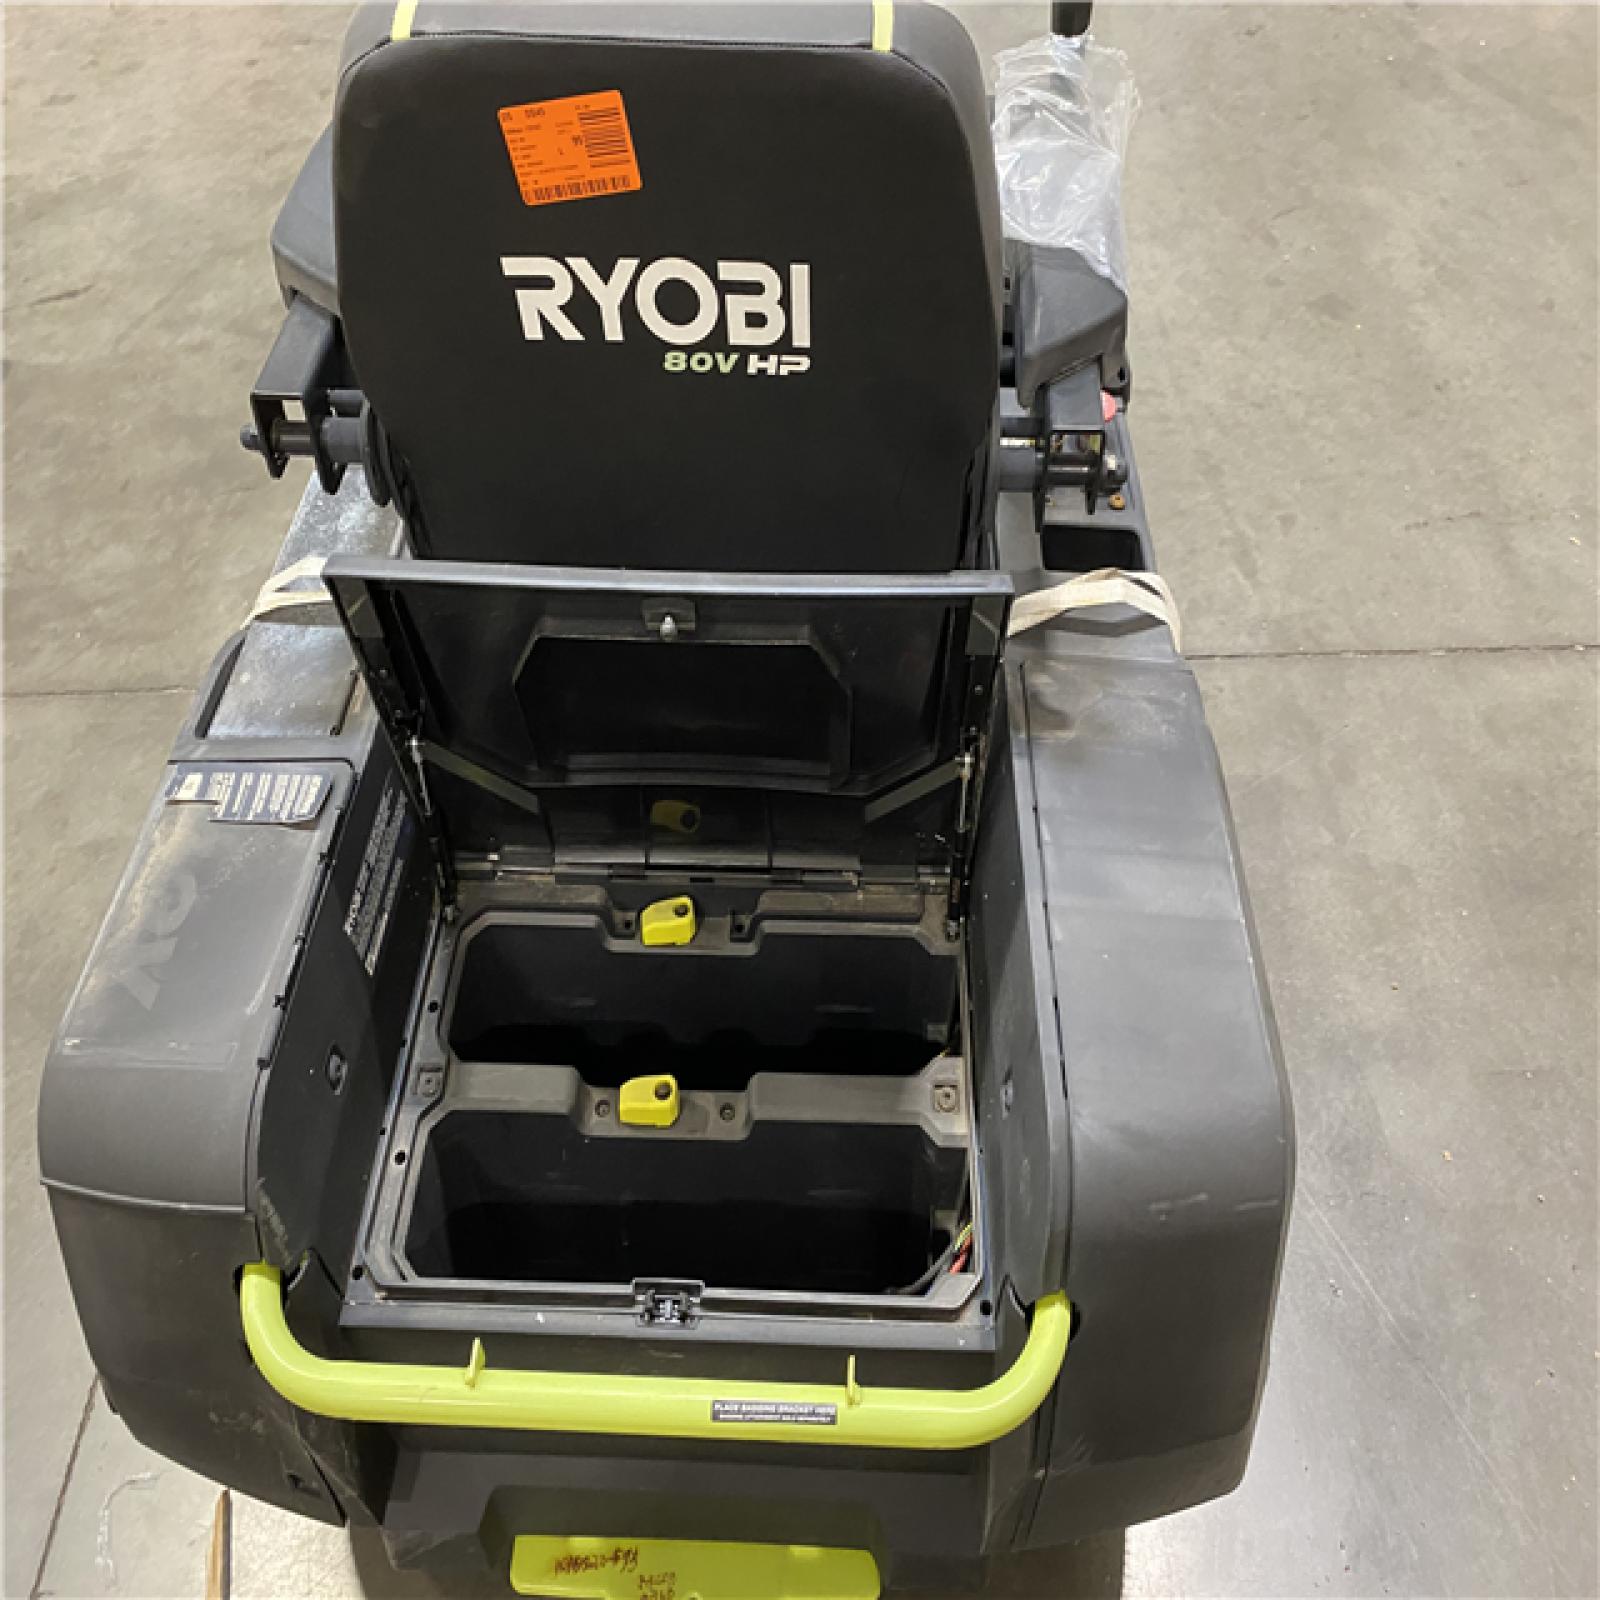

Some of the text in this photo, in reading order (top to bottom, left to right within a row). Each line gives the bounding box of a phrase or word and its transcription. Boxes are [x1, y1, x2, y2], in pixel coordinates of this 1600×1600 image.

[500, 256, 811, 348] RYOBI
[663, 351, 811, 376] 80V HP
